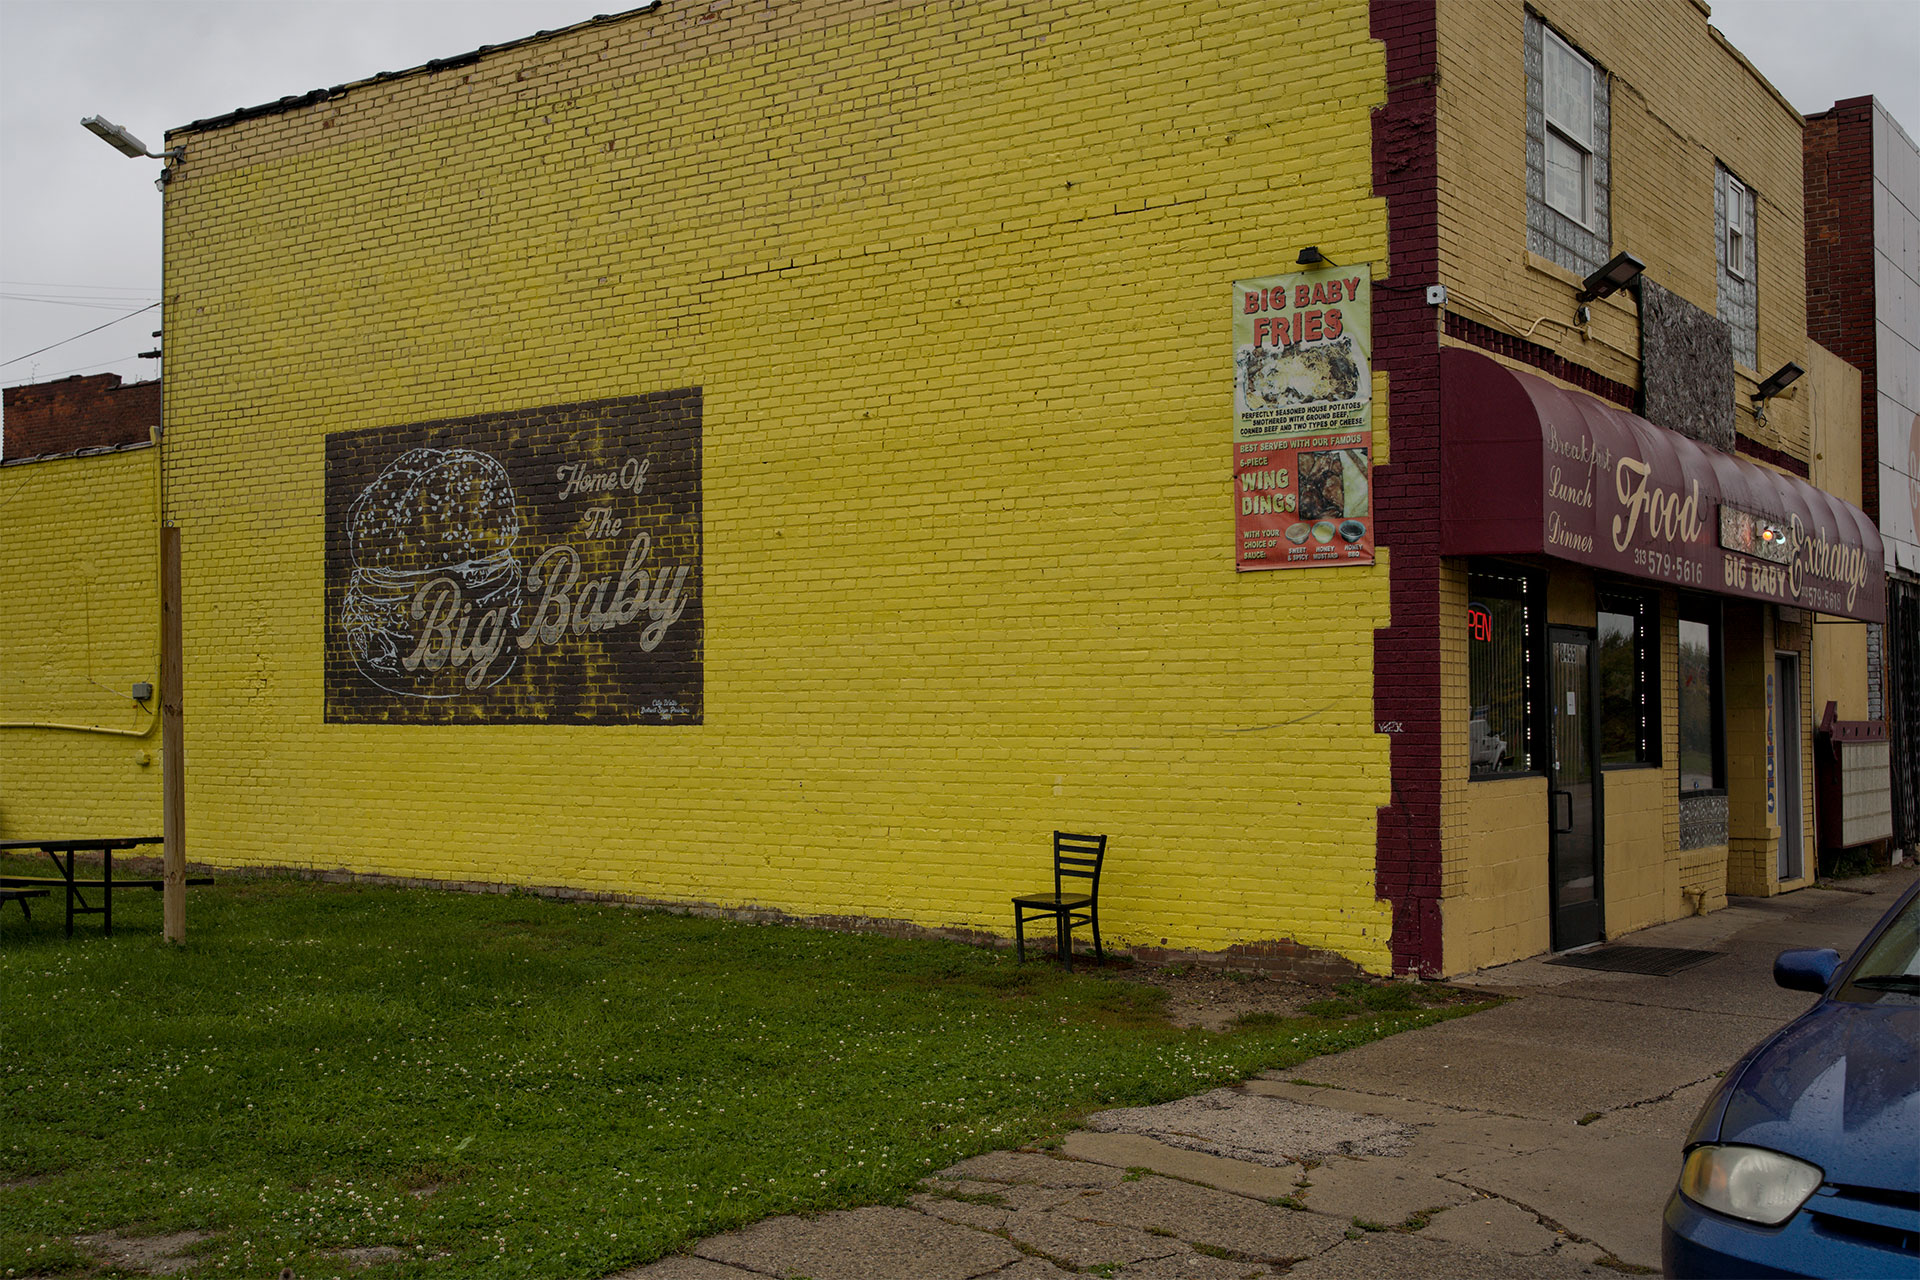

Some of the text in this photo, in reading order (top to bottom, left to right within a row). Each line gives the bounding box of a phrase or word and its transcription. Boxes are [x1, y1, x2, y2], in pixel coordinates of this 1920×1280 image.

[1244, 277, 1360, 314] BIG BABY
[1253, 309, 1344, 347] FRIES
[1241, 401, 1361, 420] PERFECTLY SEASONED HOUSE POTATOES
[1252, 411, 1350, 426] SMOTHERED WITH GROUND BEEF,
[1240, 426, 1263, 436] CORNED
[1264, 425, 1279, 433] BEEF
[1294, 422, 1307, 430] TWO
[1308, 420, 1328, 429] TYPES
[1329, 419, 1338, 427] OF
[1339, 417, 1363, 426] CHEESE
[1240, 434, 1362, 454] BEST SERVED WITH OUR FAMOUS
[557, 457, 650, 500] Home Of
[1241, 468, 1290, 492] WING
[1548, 464, 1593, 509] Lunch
[1242, 493, 1297, 516] DINGS
[584, 505, 622, 539] The
[1243, 529, 1280, 539] WITH YOUR
[1548, 510, 1594, 554] Dinner
[1612, 456, 1868, 613] Food Exchange
[1244, 539, 1278, 549] CHOICE OF
[1293, 553, 1309, 561] SPICY
[1634, 547, 1647, 566] 313
[1724, 553, 1786, 598] BIG BABY
[402, 531, 691, 691] Big Baby
[1468, 609, 1491, 642] PEN
